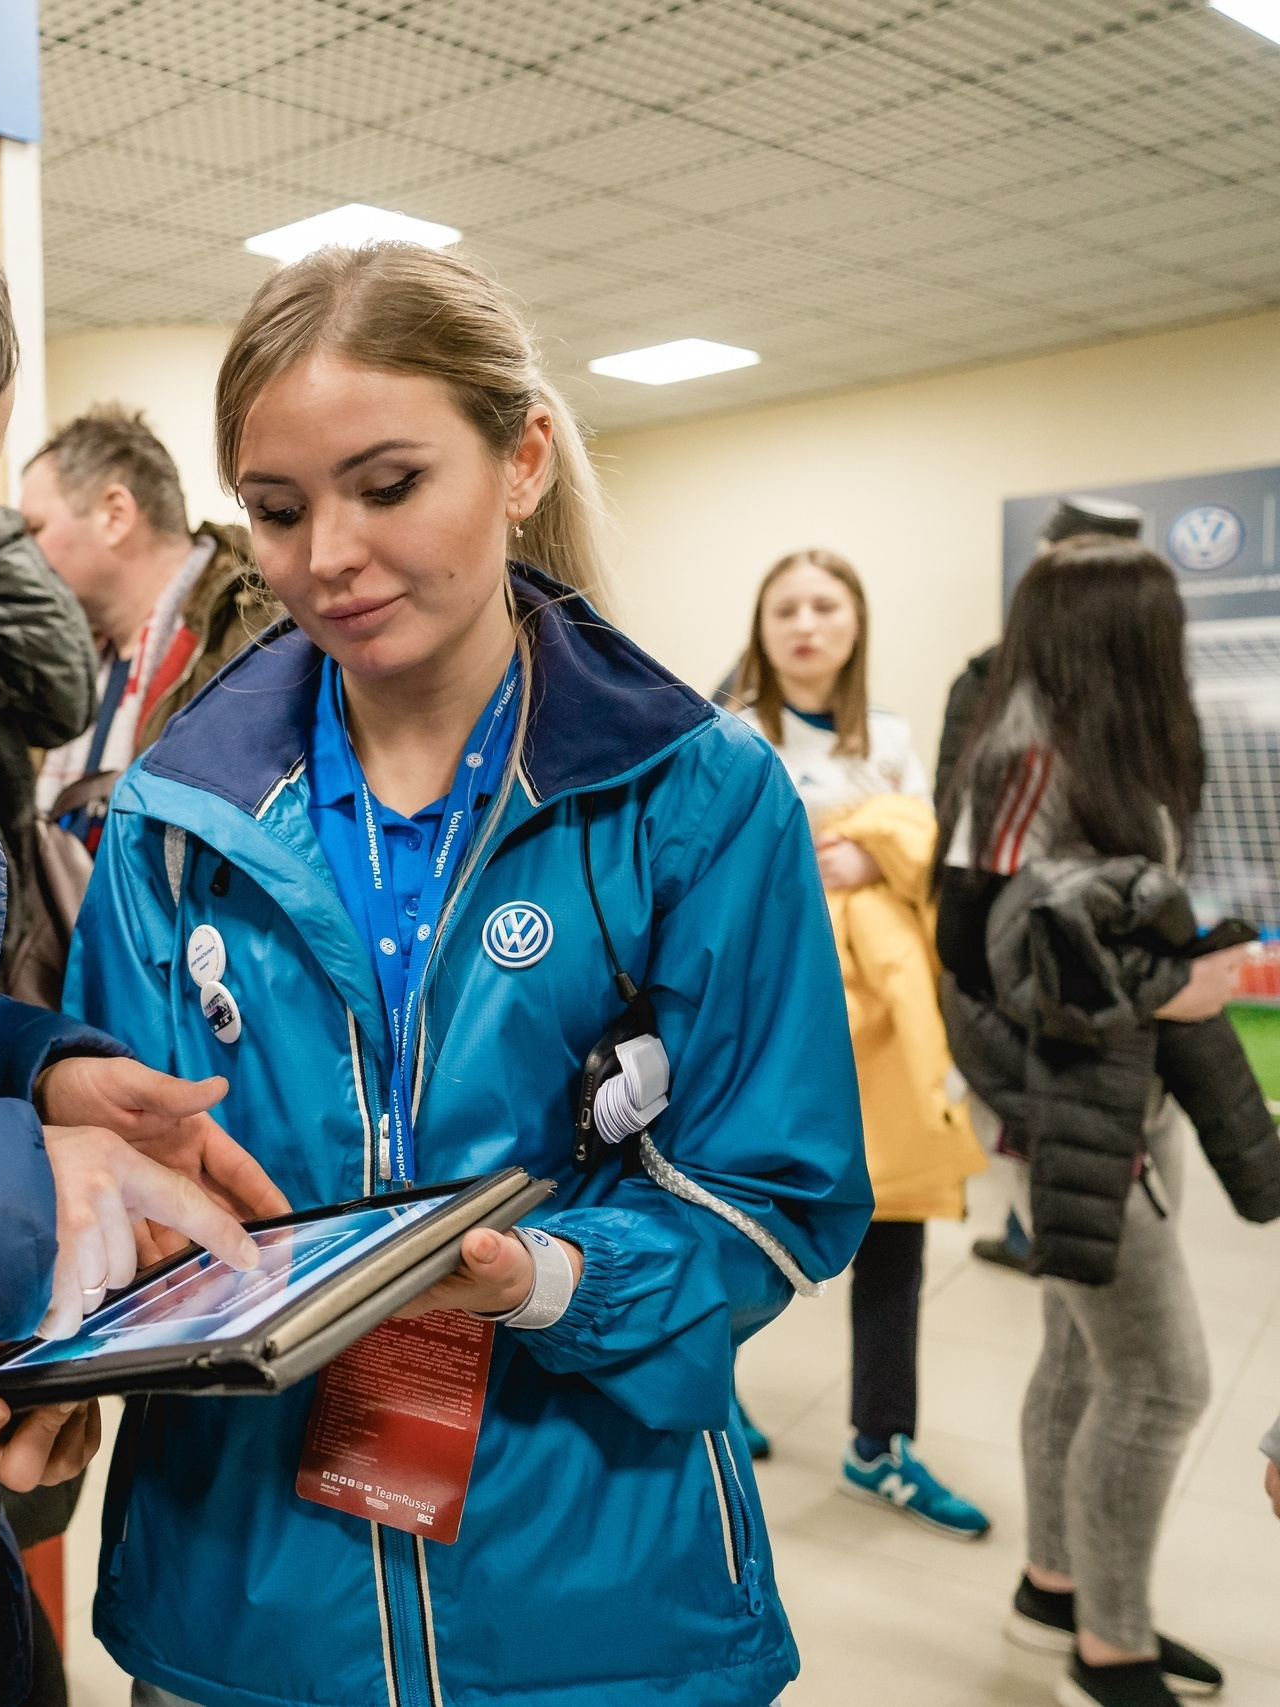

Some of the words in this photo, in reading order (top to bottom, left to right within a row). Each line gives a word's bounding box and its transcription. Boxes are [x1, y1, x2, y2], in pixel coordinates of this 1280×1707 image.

[361, 782, 383, 891] www.volkswagen.ru
[433, 810, 464, 879] Volkswagen
[375, 1485, 436, 1514] TeamRussia
